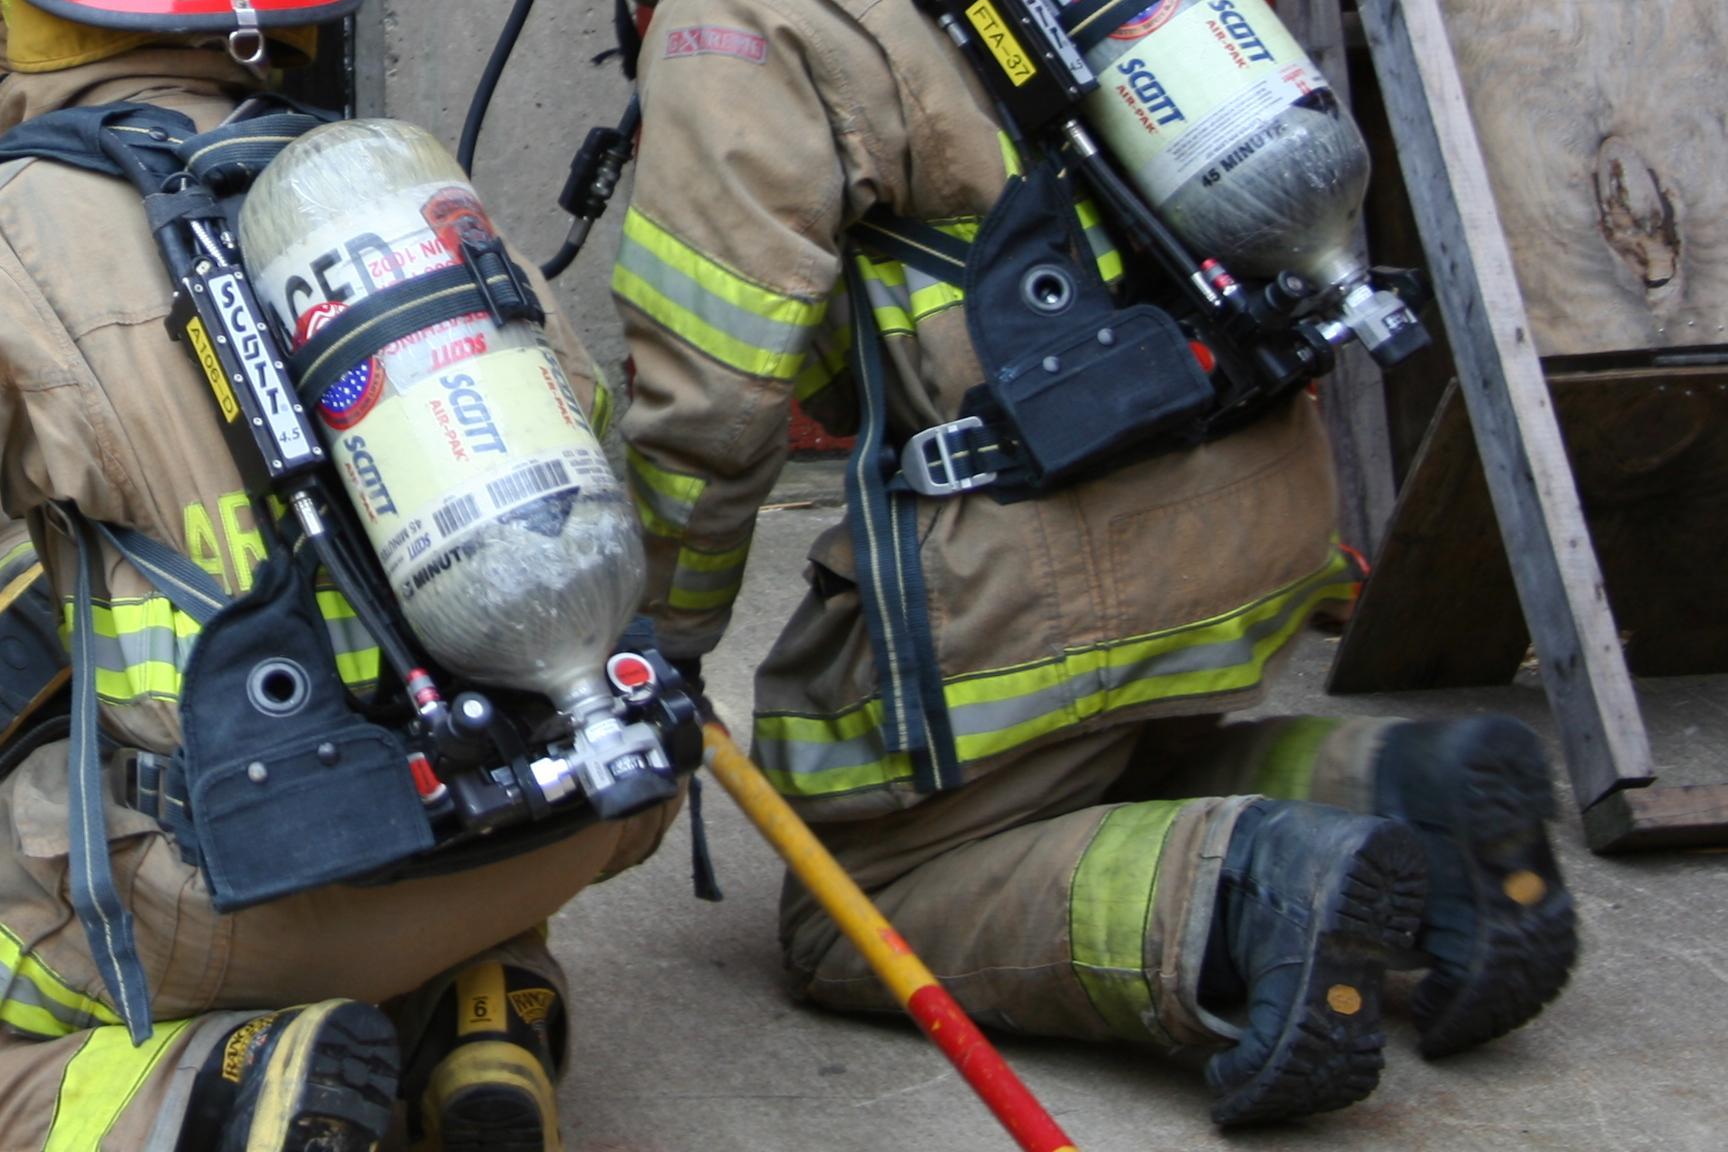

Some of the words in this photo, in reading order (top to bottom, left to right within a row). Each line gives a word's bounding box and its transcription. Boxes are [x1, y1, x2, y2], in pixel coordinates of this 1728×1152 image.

[973, 6, 1030, 77] FTA-37
[1206, 20, 1247, 69] AIR-PAK
[1208, 0, 1275, 63] SCOTT
[1116, 85, 1158, 134] AIR-PAK
[1117, 58, 1186, 126] SCOTT
[190, 327, 234, 414] A106-D
[220, 281, 280, 415] SCOTT
[431, 333, 487, 371] SCOTT
[279, 427, 301, 443] 4.5
[429, 400, 467, 462] AIR-PAK
[440, 373, 507, 454] SCOTT
[343, 434, 399, 519] SCOTT
[473, 1000, 488, 1018] 6
